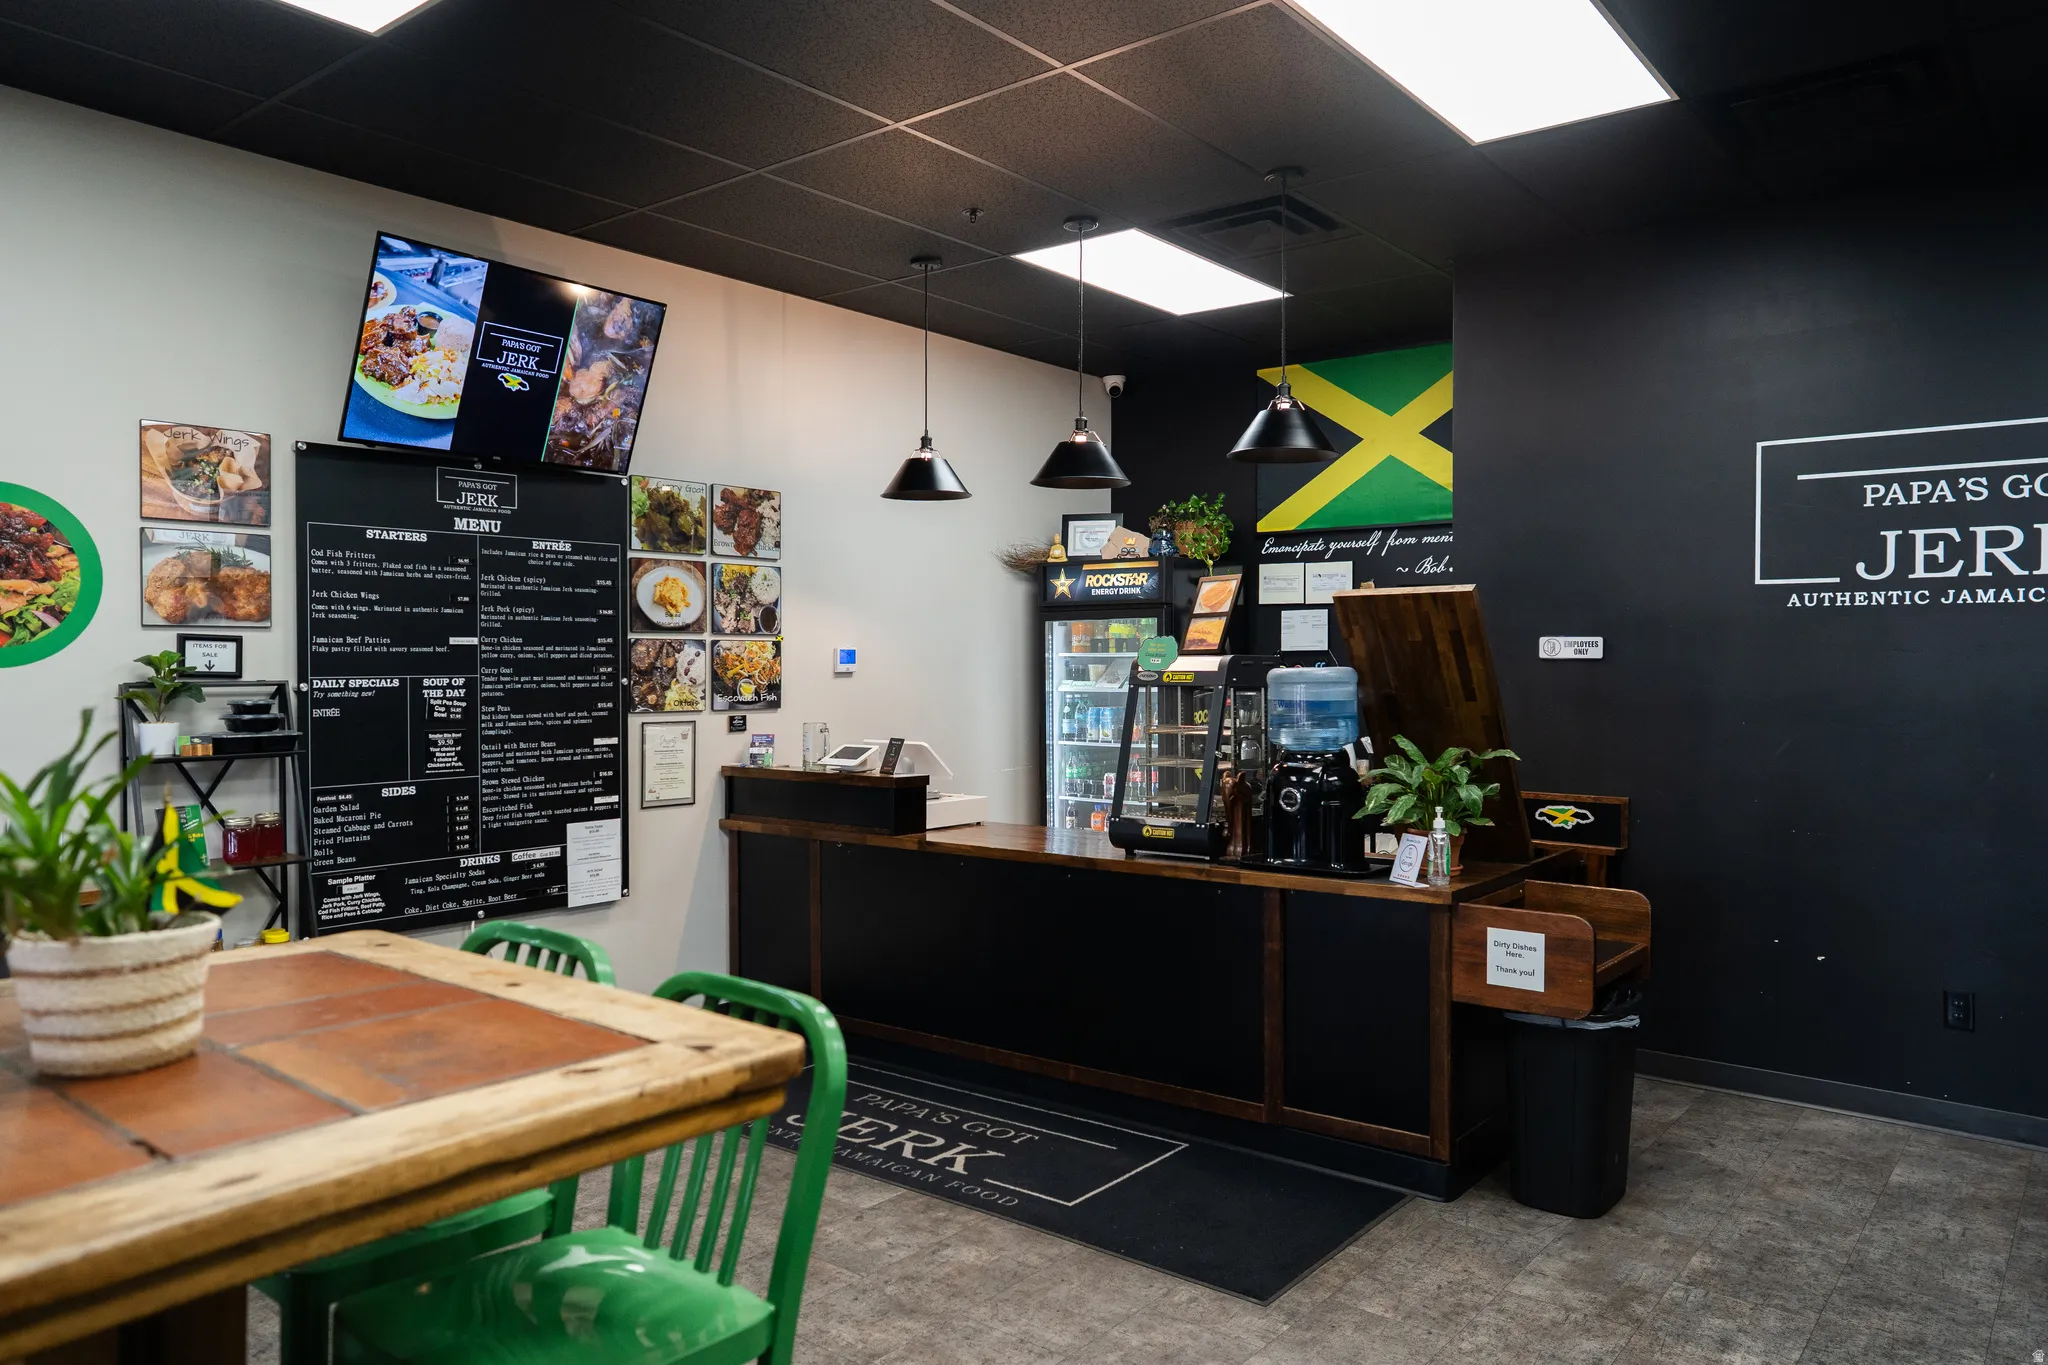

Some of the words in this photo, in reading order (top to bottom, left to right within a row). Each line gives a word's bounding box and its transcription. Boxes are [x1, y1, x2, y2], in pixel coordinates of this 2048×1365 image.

[502, 339, 525, 349] PAPA'S
[526, 344, 541, 353] GOT
[496, 351, 540, 370] JERK
[481, 363, 510, 371] AUTHENTIC
[510, 368, 534, 376] JAMAICAN
[163, 428, 201, 441] Jerk
[209, 429, 250, 452] Wings
[458, 480, 481, 489] PAPA'S
[482, 482, 498, 491] GOT
[686, 484, 704, 493] Goat
[1863, 477, 1989, 507] PAPA'S
[456, 491, 499, 508] JERK
[453, 516, 502, 533] MENU
[179, 532, 210, 541] JERK
[366, 529, 427, 542] STARTERS
[532, 541, 572, 552] ENTRÉE
[713, 539, 734, 548] Brown
[1261, 536, 1326, 558] Emancipate
[1328, 530, 1383, 560] yourself
[1381, 529, 1419, 557] from
[311, 549, 323, 557] Cod
[326, 550, 342, 558] Fish
[346, 551, 376, 559] Fritters
[1856, 523, 2048, 580] JER
[1414, 555, 1448, 575] Bob
[523, 576, 546, 584] (spicy)
[1085, 572, 1148, 588] ROCKSTAR
[331, 591, 357, 599] Chicken
[360, 592, 379, 600] Wings
[1787, 590, 1930, 607] AUTHENTIC
[1941, 587, 2048, 605] JAMAIC
[313, 680, 346, 688] DAILY
[349, 679, 399, 687] SPECIALS
[760, 693, 777, 701] Fish
[313, 708, 340, 717] ENTRÉE
[382, 786, 416, 797] SIDES
[482, 805, 518, 813] Escovitched
[314, 816, 334, 824] Baked
[336, 814, 367, 822] Macaroni
[314, 826, 341, 835] Steamed
[344, 824, 371, 832] Cabbage
[388, 820, 413, 828] Carrots
[336, 834, 370, 843] Plantains
[460, 854, 500, 867] DRINKS
[513, 852, 536, 860] Coffee
[328, 877, 352, 885] Sample
[405, 876, 433, 884] Jamaican
[436, 872, 466, 882] Specialty
[462, 898, 485, 907] Sprite,
[1494, 940, 1510, 949] Dirty
[1512, 943, 1537, 952] Dishes
[1495, 965, 1517, 974] Thank
[854, 1093, 960, 1125] PAPA'S
[961, 1121, 1040, 1144] GOT
[944, 1180, 1019, 1206] FOOD
